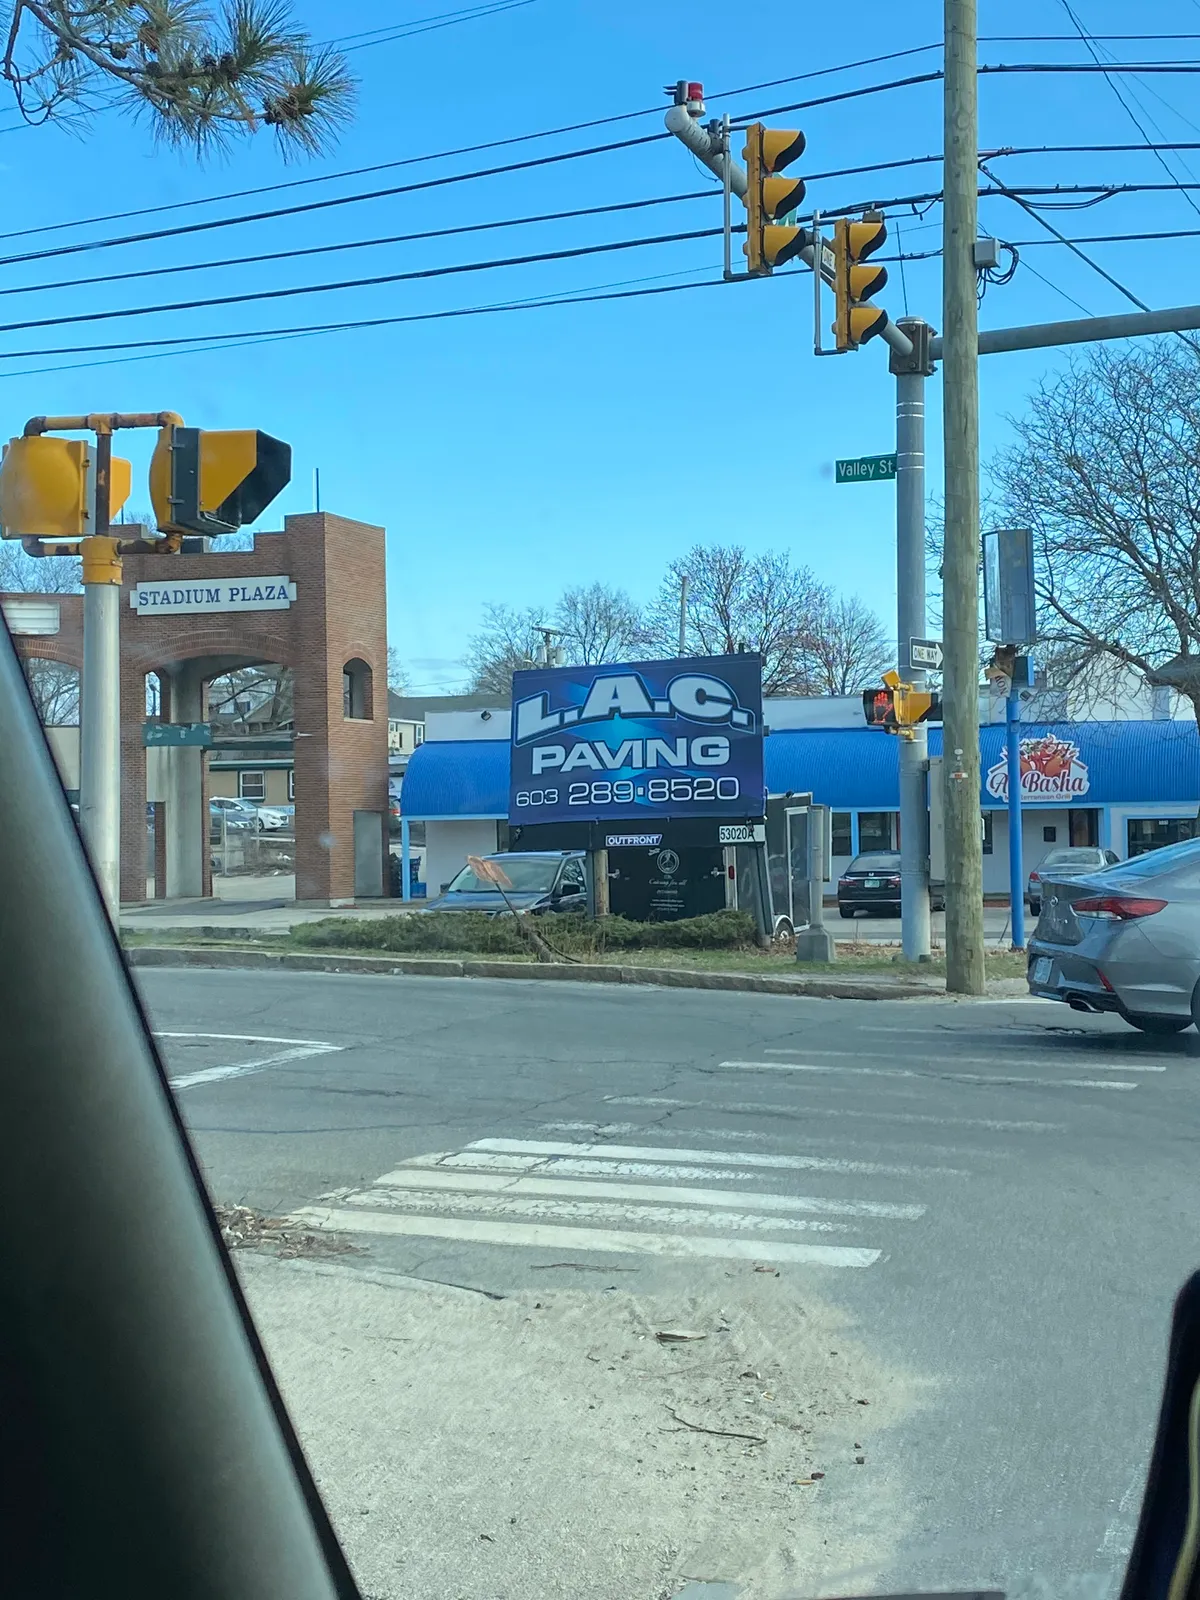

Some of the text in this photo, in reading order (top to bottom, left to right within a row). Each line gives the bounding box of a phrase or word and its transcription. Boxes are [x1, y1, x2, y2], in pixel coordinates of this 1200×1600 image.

[839, 459, 893, 478] Valley St
[139, 585, 289, 606] STADIUM PLAZA
[913, 646, 938, 662] ONE WAY
[515, 673, 755, 746] L.A.C.
[531, 736, 731, 775] PAVING
[1022, 770, 1085, 793] Basha
[516, 788, 559, 807] 603
[608, 835, 659, 845] OUTFRONT
[720, 827, 755, 840] 53020A
